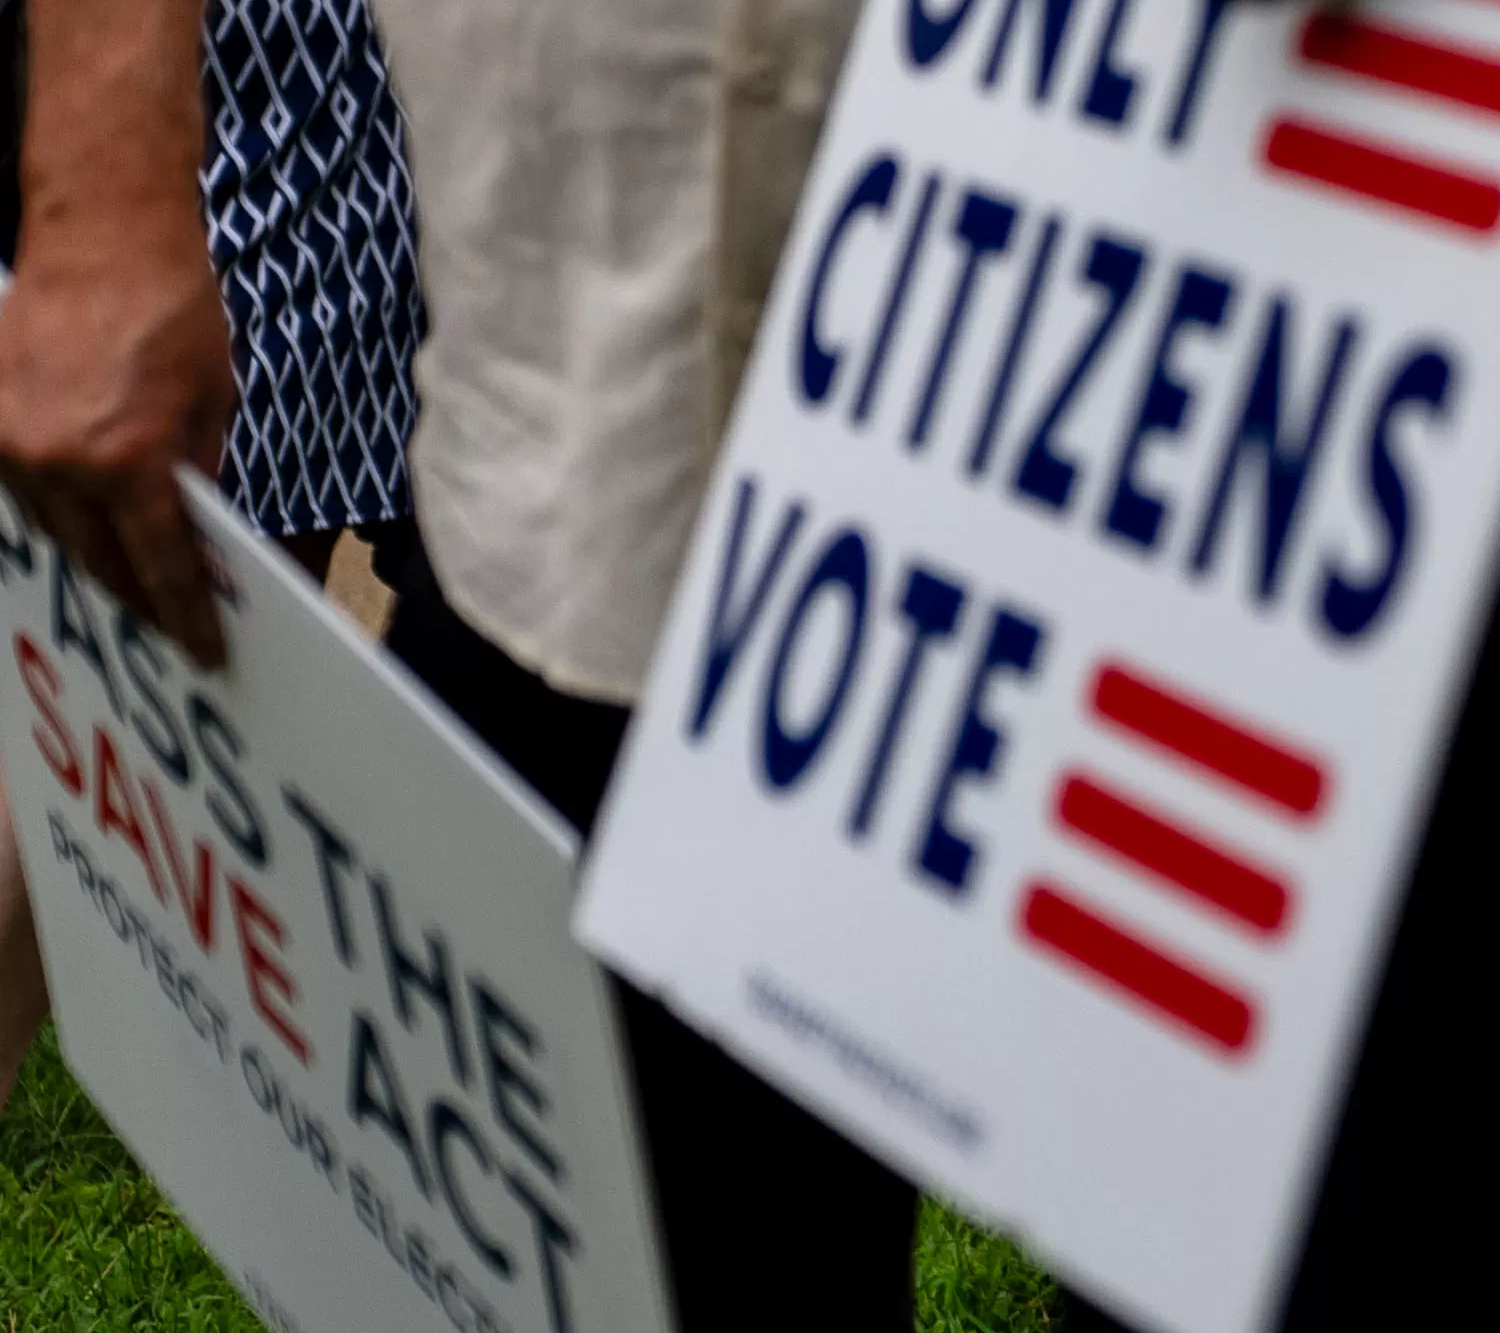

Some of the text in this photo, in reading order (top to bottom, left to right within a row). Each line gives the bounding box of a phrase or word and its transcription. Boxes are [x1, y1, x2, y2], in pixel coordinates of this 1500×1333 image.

[788, 151, 1464, 645] CITIZENS
[685, 478, 1047, 901] VOTE
[13, 629, 582, 1333] SAVE ACT
[47, 805, 232, 1064] PROTECT
[240, 1044, 341, 1195] OUR
[280, 781, 569, 1191] THE
